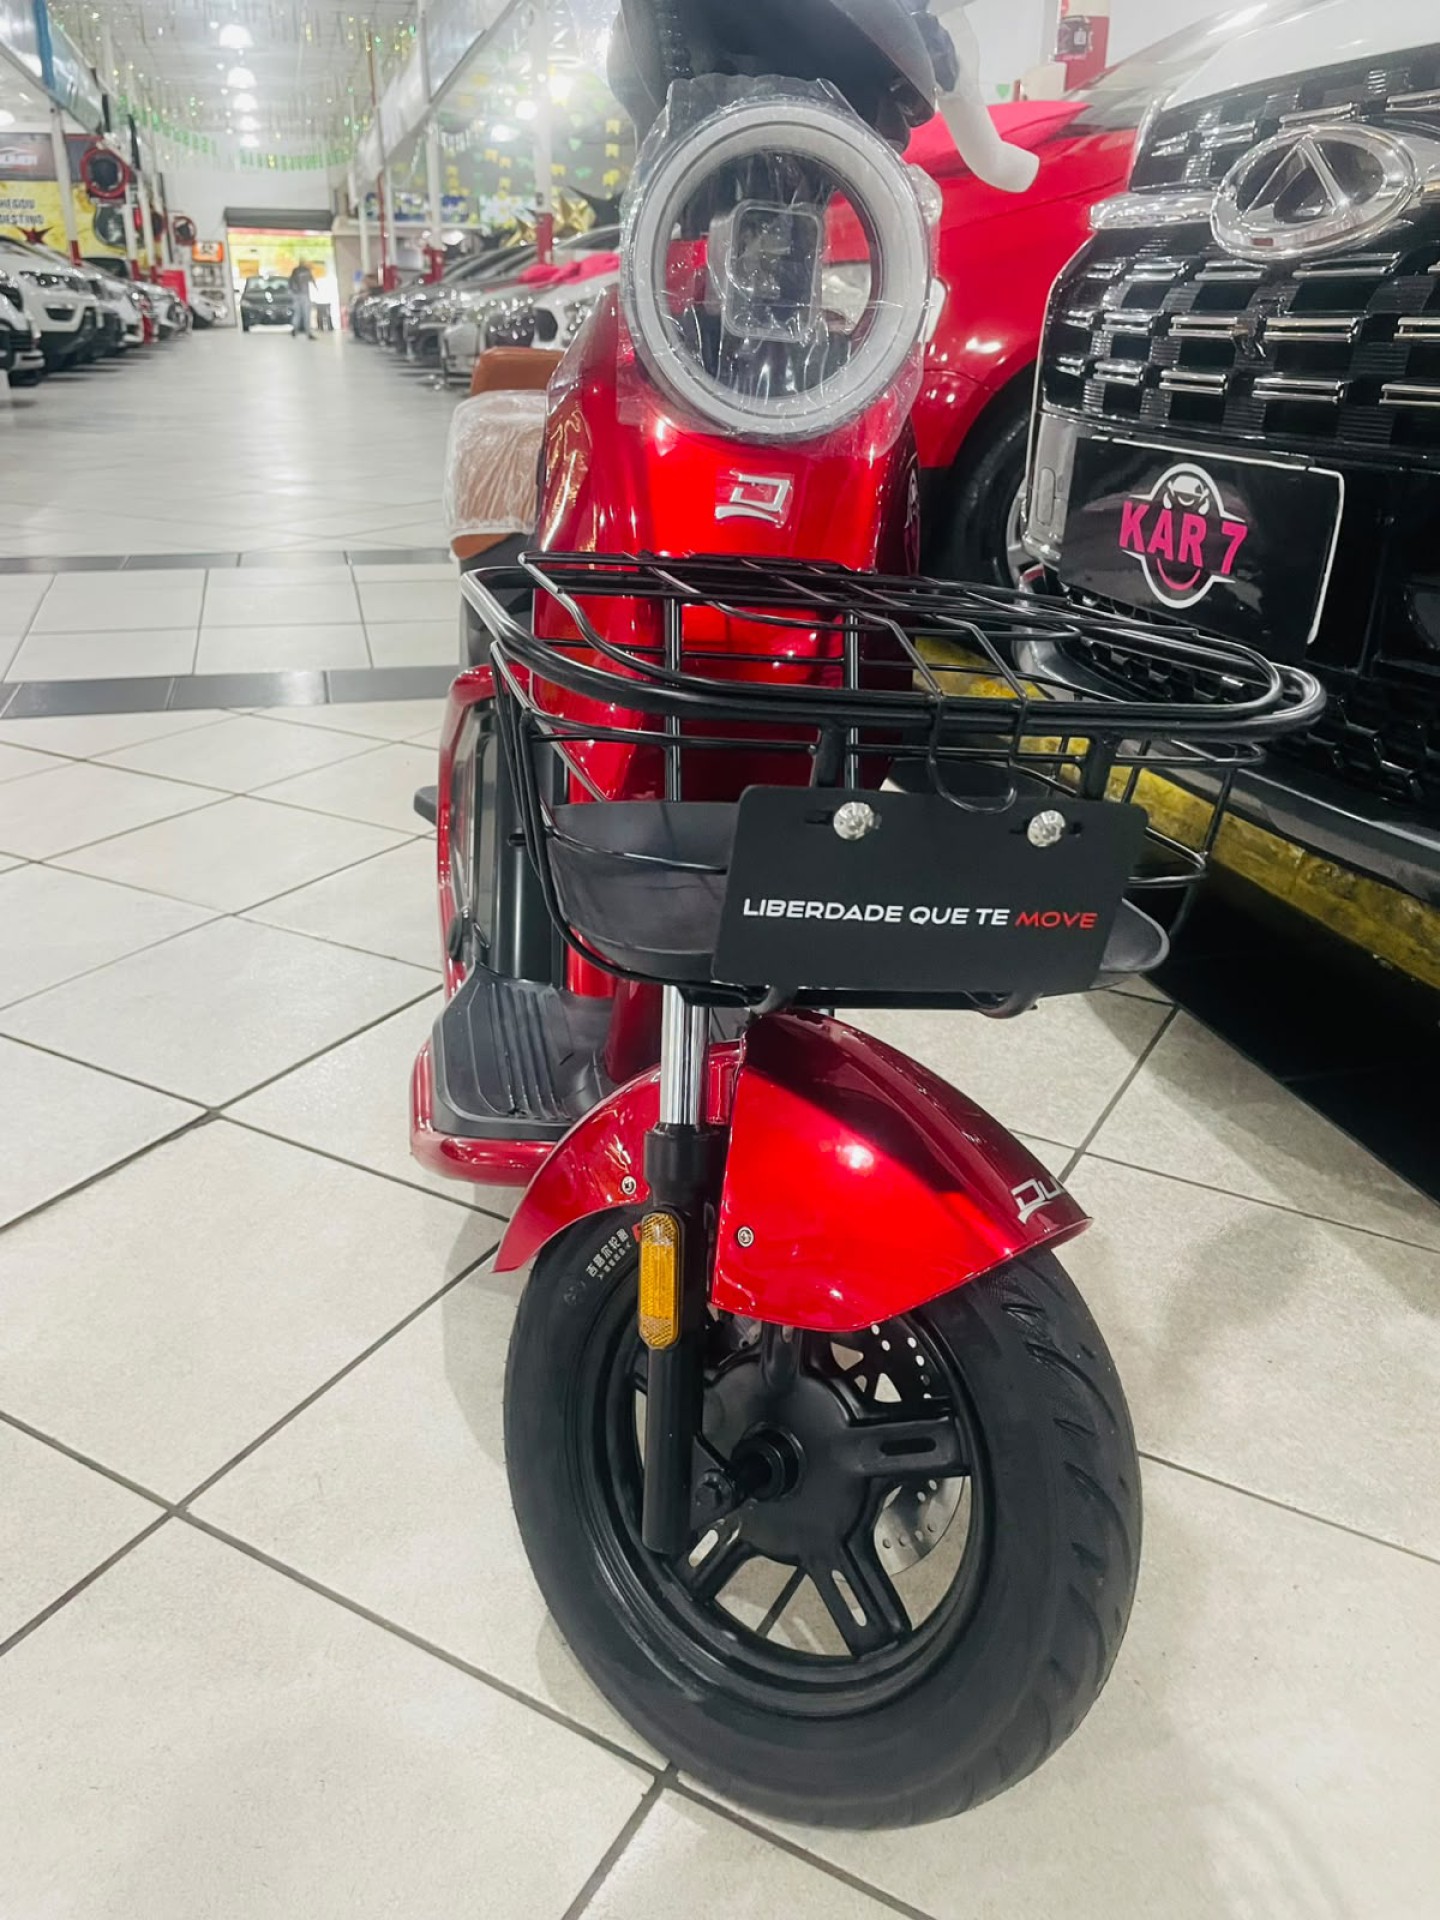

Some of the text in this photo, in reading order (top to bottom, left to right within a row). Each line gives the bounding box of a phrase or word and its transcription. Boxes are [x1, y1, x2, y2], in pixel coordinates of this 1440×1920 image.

[1119, 501, 1248, 575] KAR 7
[743, 898, 1098, 929] LIBERDADE QUE TE MOVE
